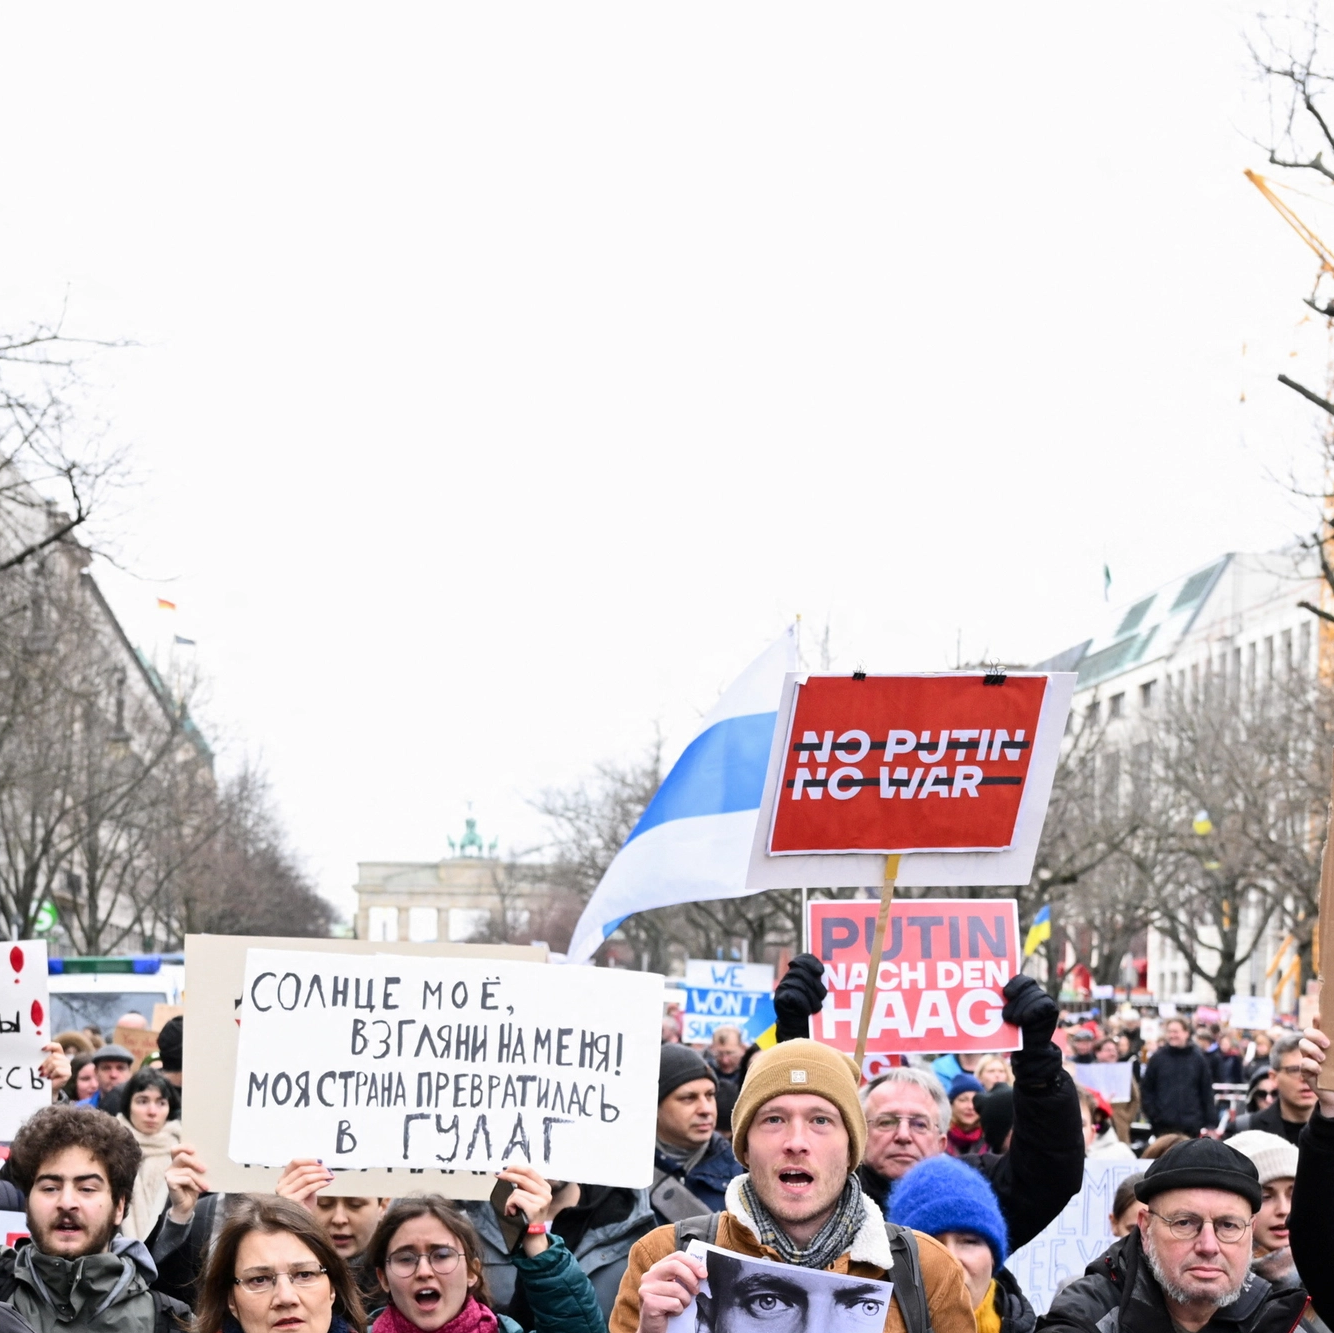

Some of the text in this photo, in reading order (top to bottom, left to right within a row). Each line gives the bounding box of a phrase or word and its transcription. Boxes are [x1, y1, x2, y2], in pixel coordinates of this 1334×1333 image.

[798, 729, 1025, 764] NO PUTIN
[791, 765, 983, 800] NO WAR
[821, 916, 1008, 961] PUTIN
[251, 971, 515, 1016] СОЛНЦЕ МОЁ,
[824, 960, 1010, 990] NACH DEN
[821, 988, 1005, 1039] HAAG
[351, 1018, 487, 1063] ВЗГЛЯНИ
[417, 1071, 620, 1123] ПРЕВРАТИЛАСЬ
[402, 1112, 575, 1164] ГУЛАГ
